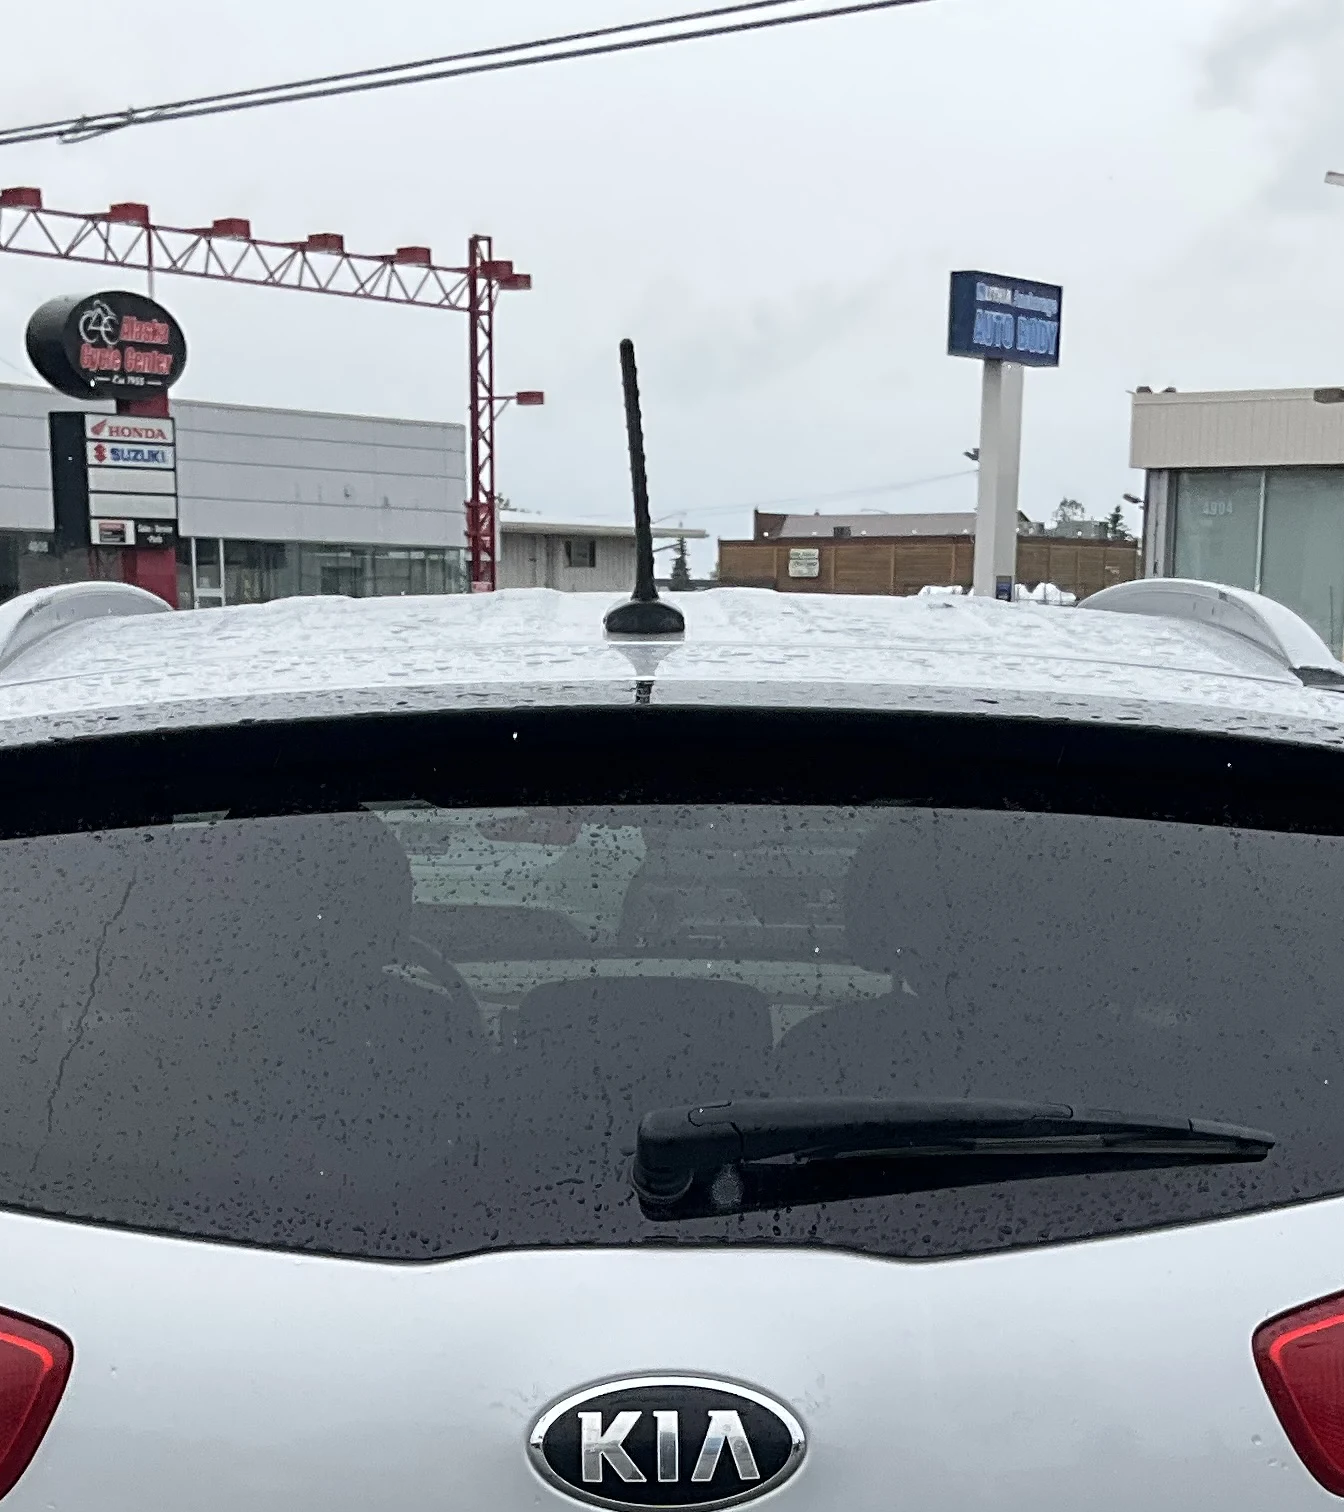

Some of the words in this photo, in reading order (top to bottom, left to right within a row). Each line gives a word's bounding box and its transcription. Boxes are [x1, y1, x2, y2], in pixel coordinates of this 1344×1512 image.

[973, 308, 1014, 349] AUTO
[1016, 315, 1058, 355] BODY
[80, 343, 122, 371] Cycle
[124, 346, 173, 375] Center
[108, 426, 168, 440] HONDA
[110, 447, 166, 463] SUZUKI
[577, 1410, 761, 1482] KIA
